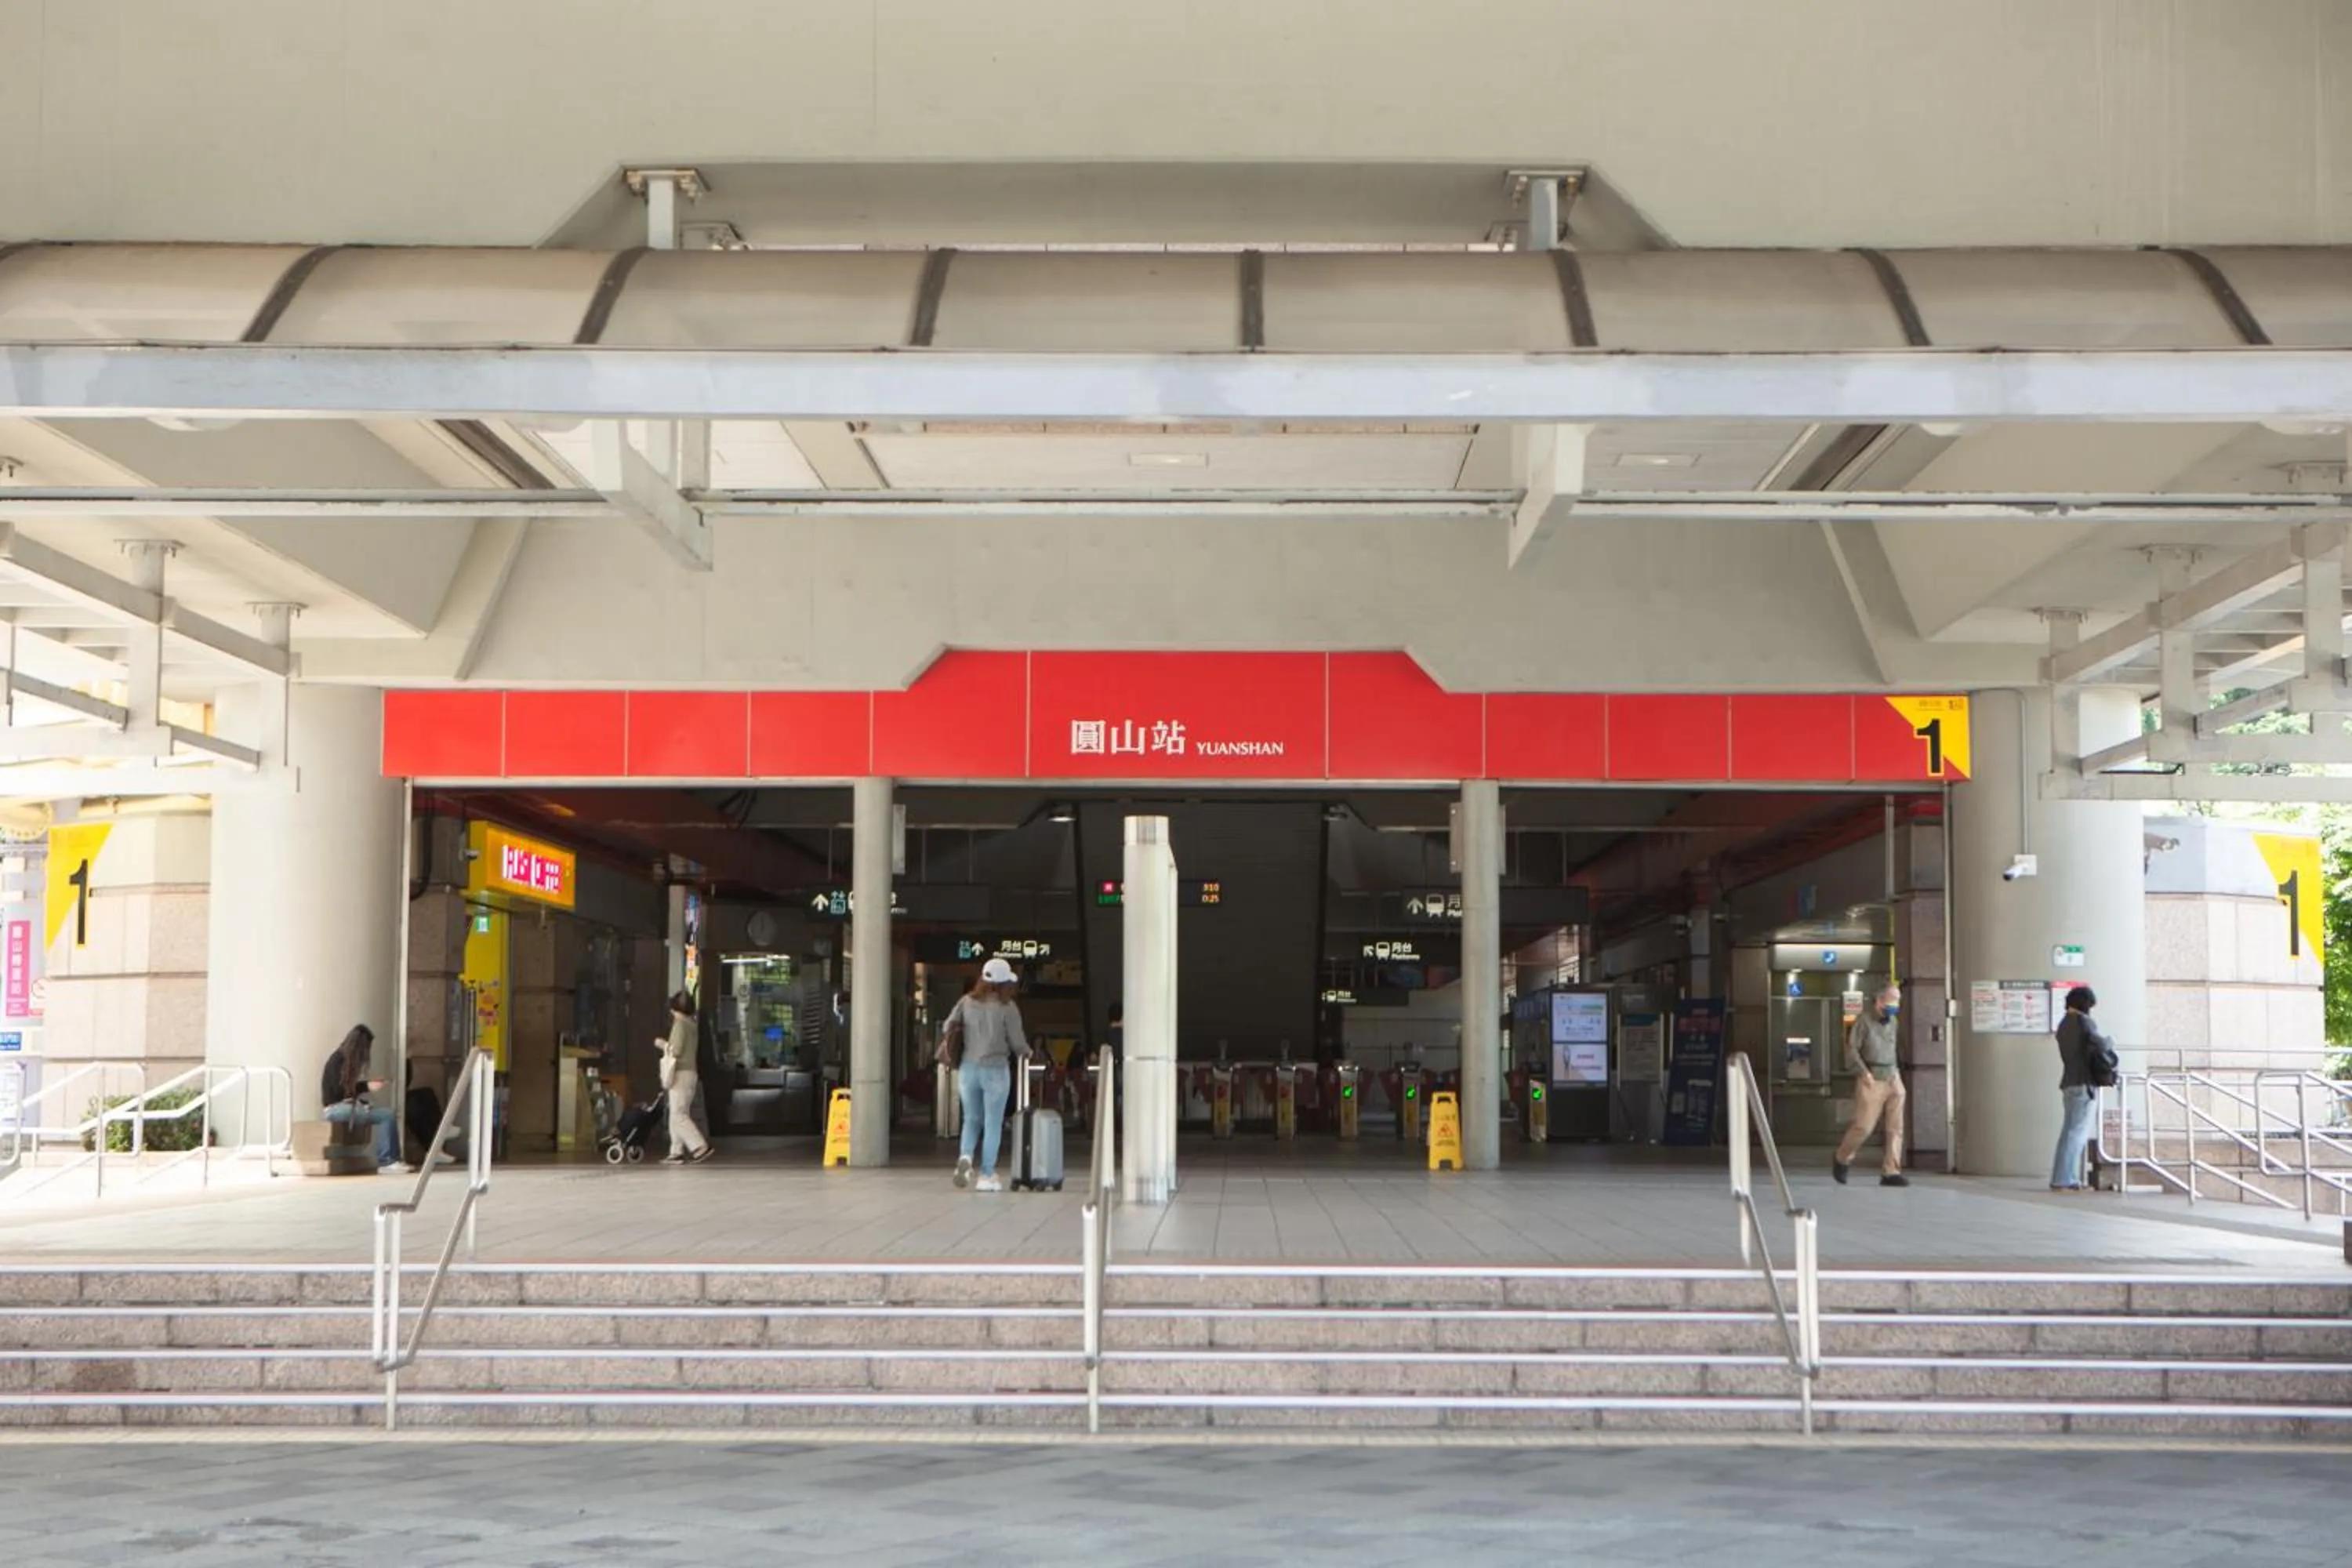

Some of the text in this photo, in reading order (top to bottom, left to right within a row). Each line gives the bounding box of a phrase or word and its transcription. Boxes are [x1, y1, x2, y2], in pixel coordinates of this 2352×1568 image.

[1071, 719, 1283, 755] 圓山站 YUANSHAN
[1916, 718, 1941, 774] 1
[69, 858, 88, 945] 1
[2278, 869, 2299, 956] 1
[1392, 942, 1412, 953] 月台
